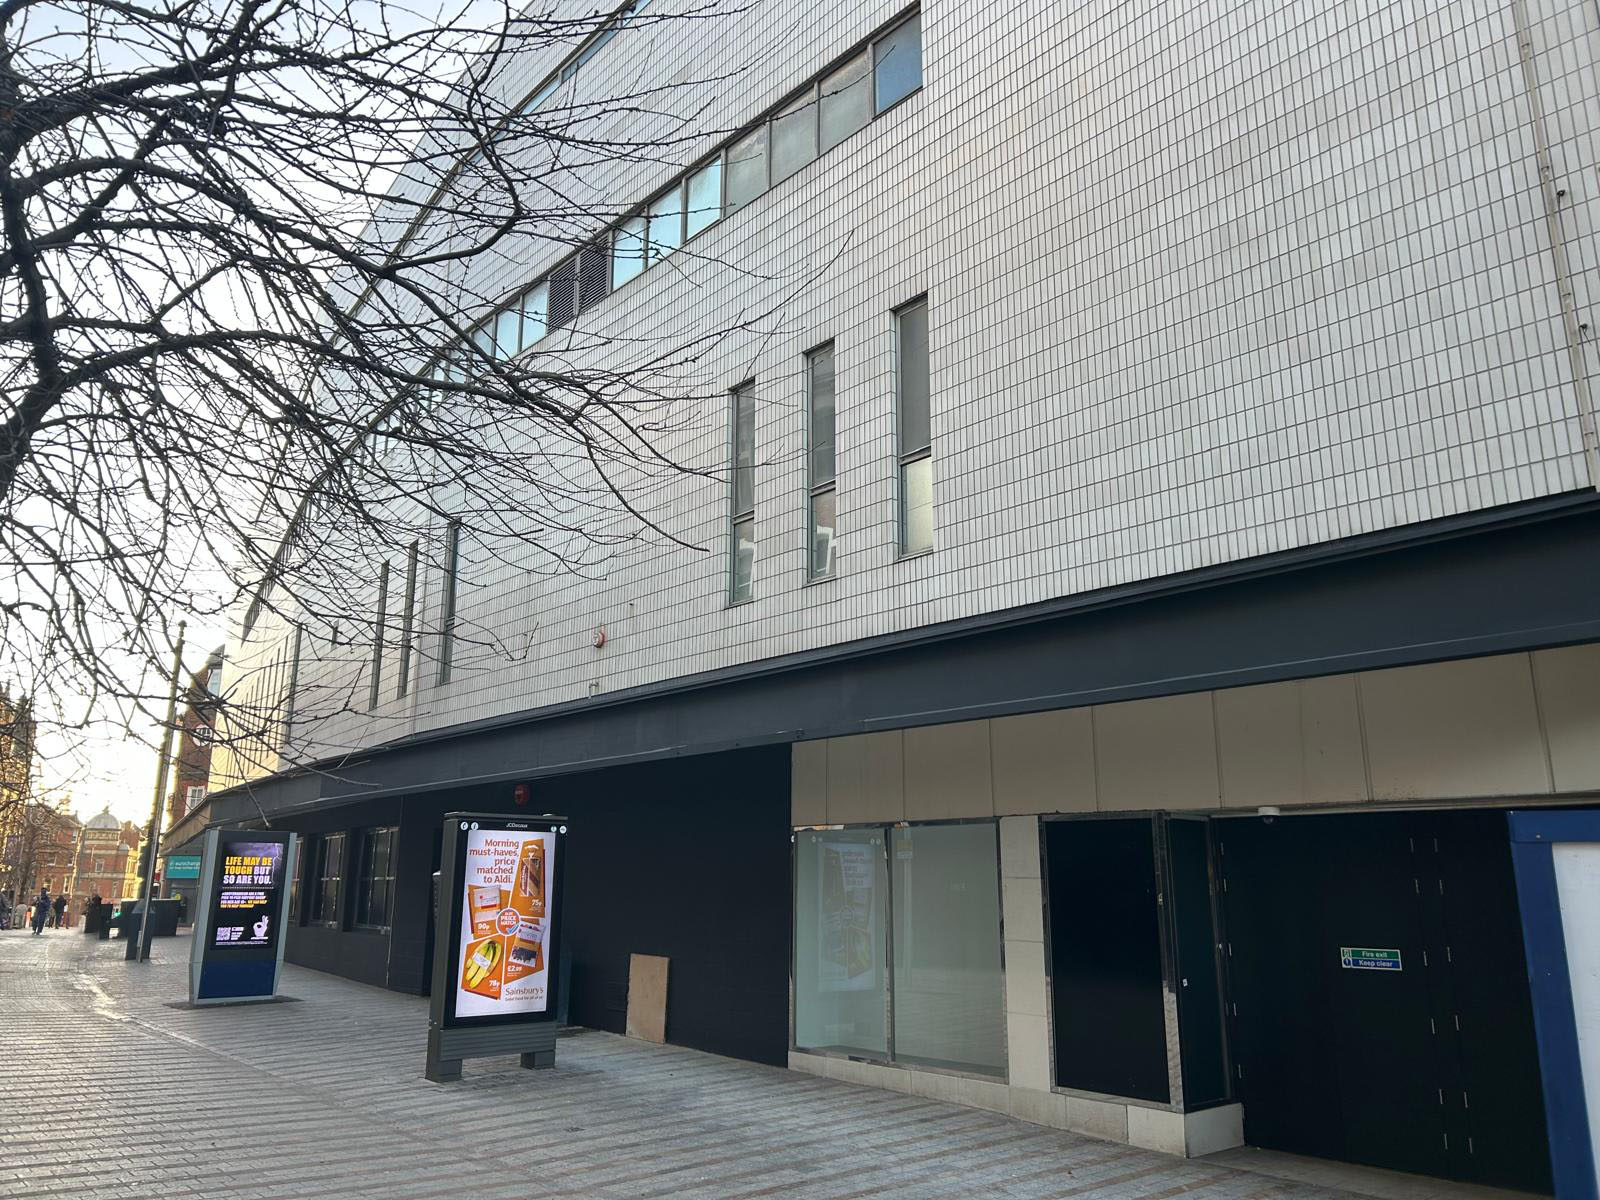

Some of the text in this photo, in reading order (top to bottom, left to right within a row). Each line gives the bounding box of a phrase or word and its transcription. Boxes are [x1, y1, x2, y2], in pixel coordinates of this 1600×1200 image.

[484, 839, 519, 849] Morning
[469, 848, 520, 857] must-haves,
[225, 856, 273, 866] LIFE MAY BE
[494, 857, 516, 867] price
[224, 866, 271, 875] TOUGH BUT
[476, 866, 514, 875] matched
[223, 875, 272, 885] SO ARE YOU.
[483, 875, 513, 883] to Aldi.
[505, 987, 544, 996] Sainsbury's
